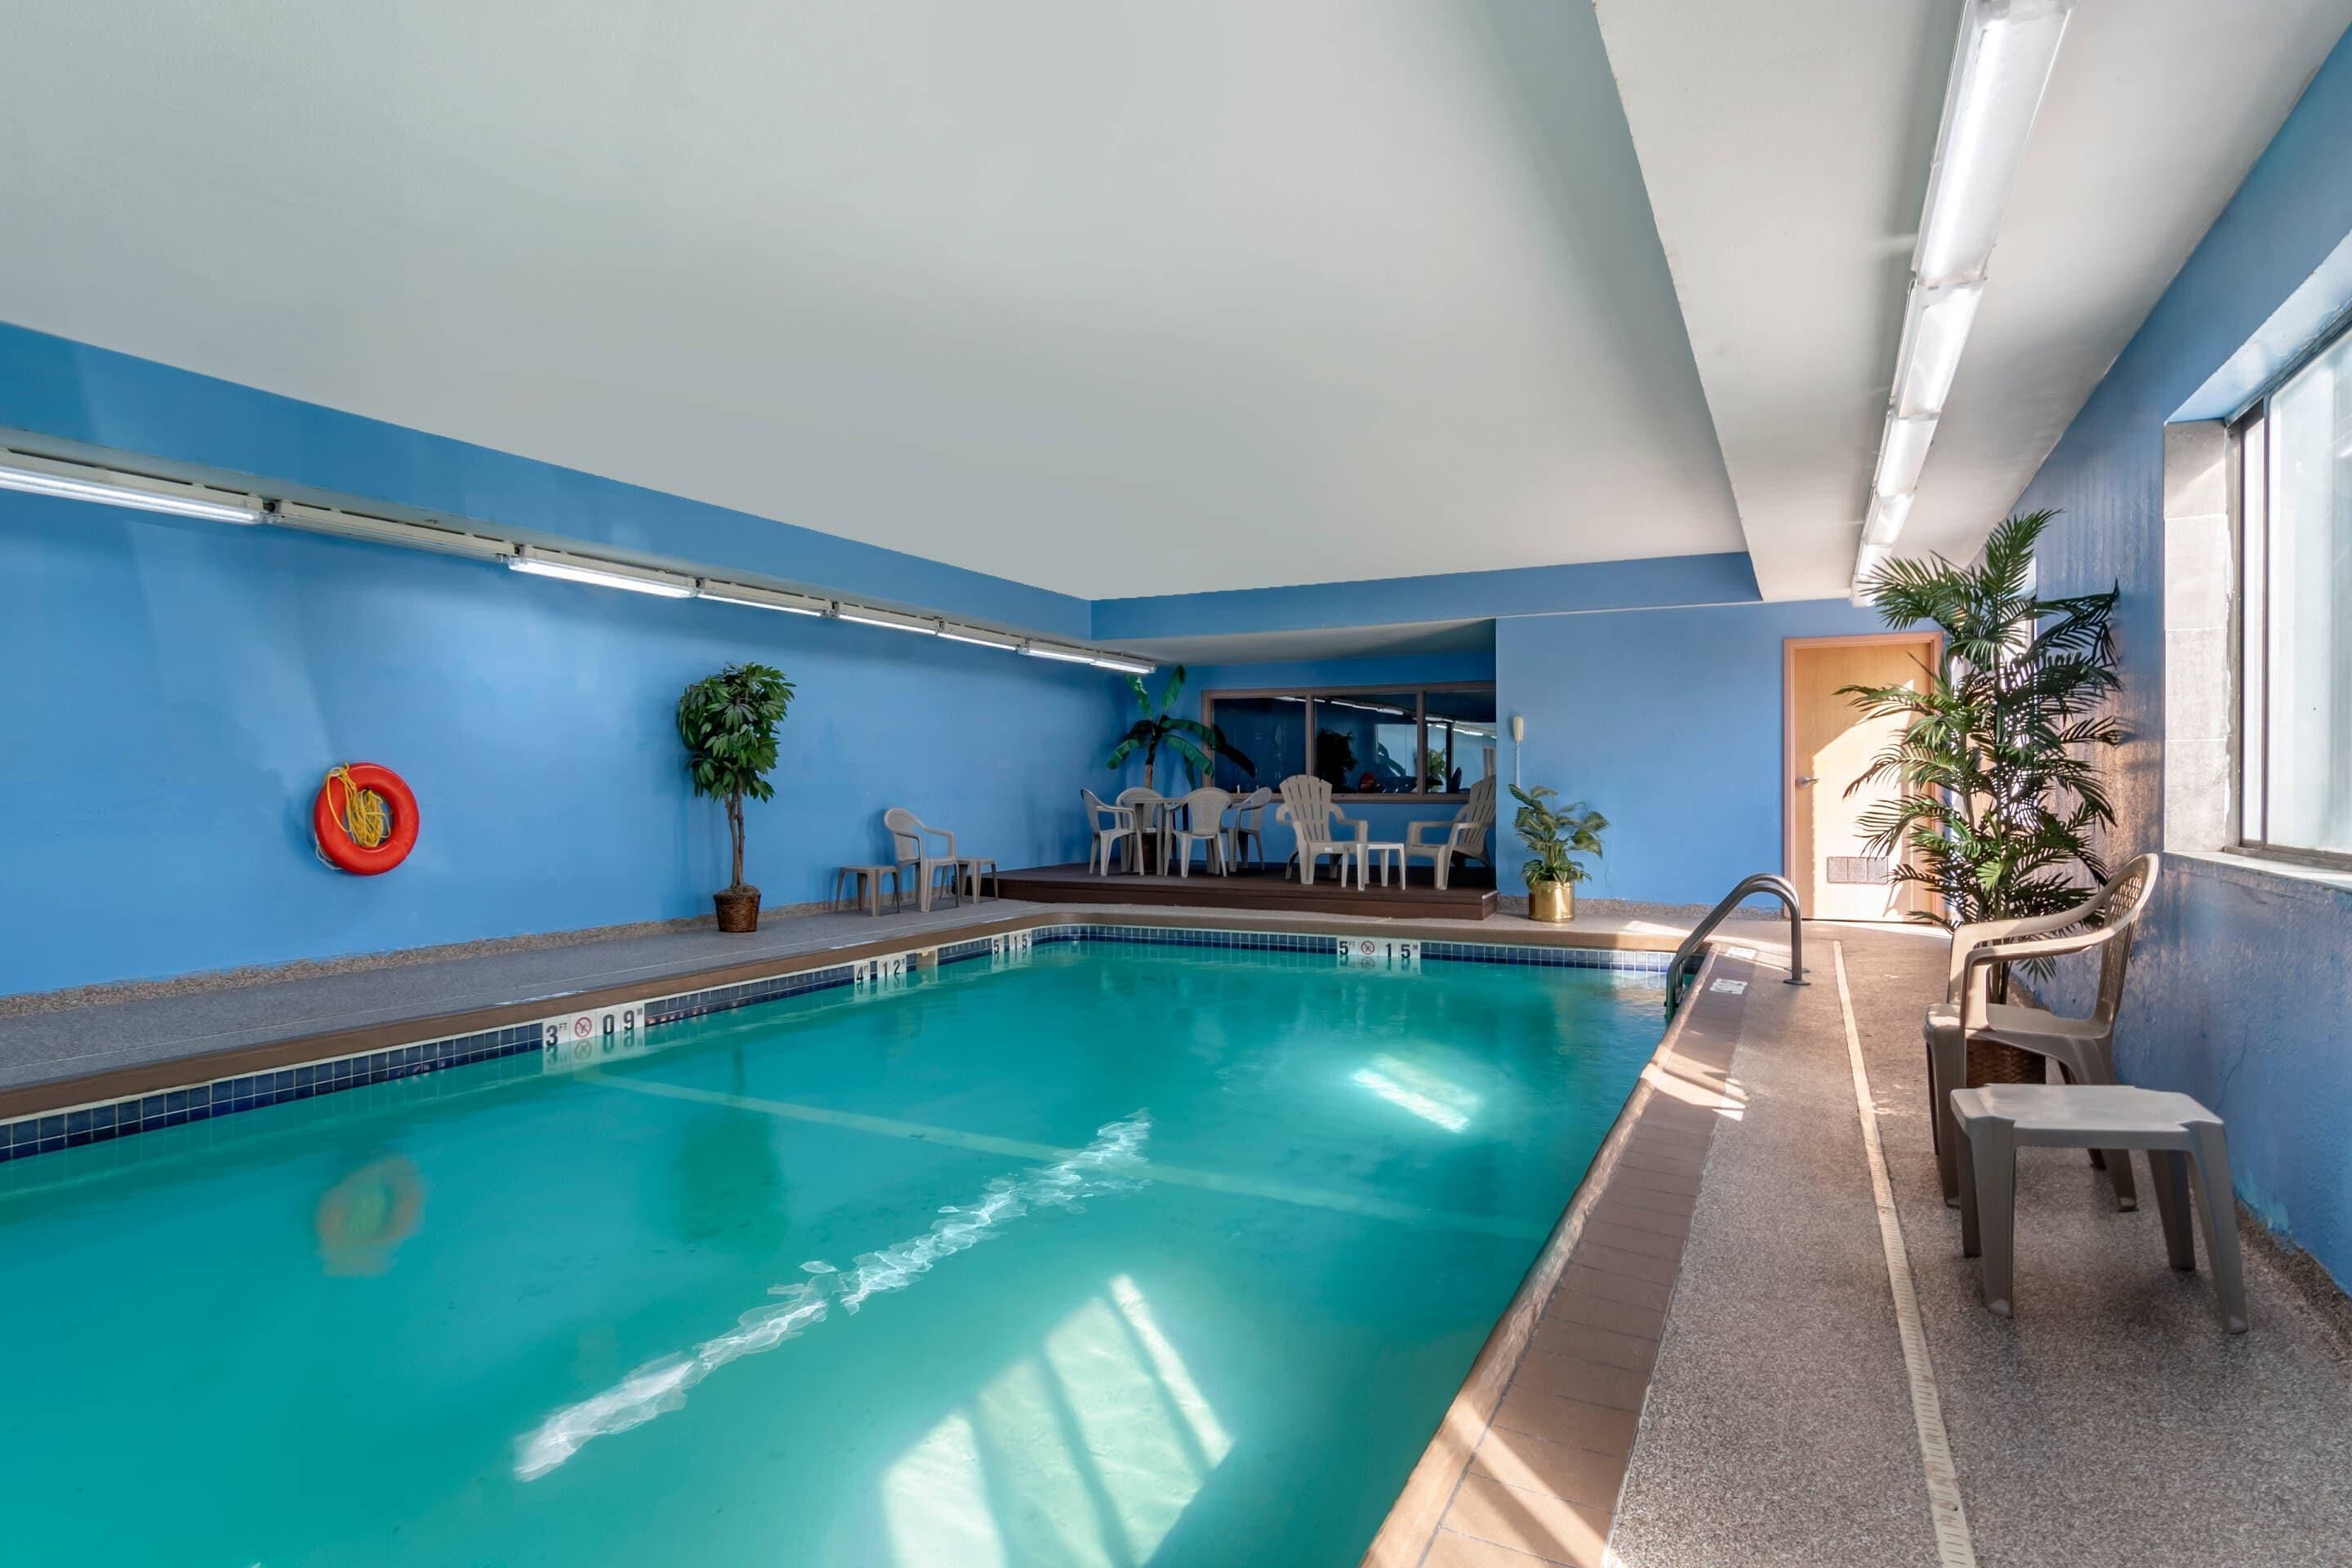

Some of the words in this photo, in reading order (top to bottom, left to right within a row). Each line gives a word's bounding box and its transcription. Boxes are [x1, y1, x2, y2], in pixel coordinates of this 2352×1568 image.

[994, 939, 1000, 954] 5
[1339, 941, 1348, 955] 5
[857, 966, 864, 981] 4
[546, 1025, 559, 1046] 3
